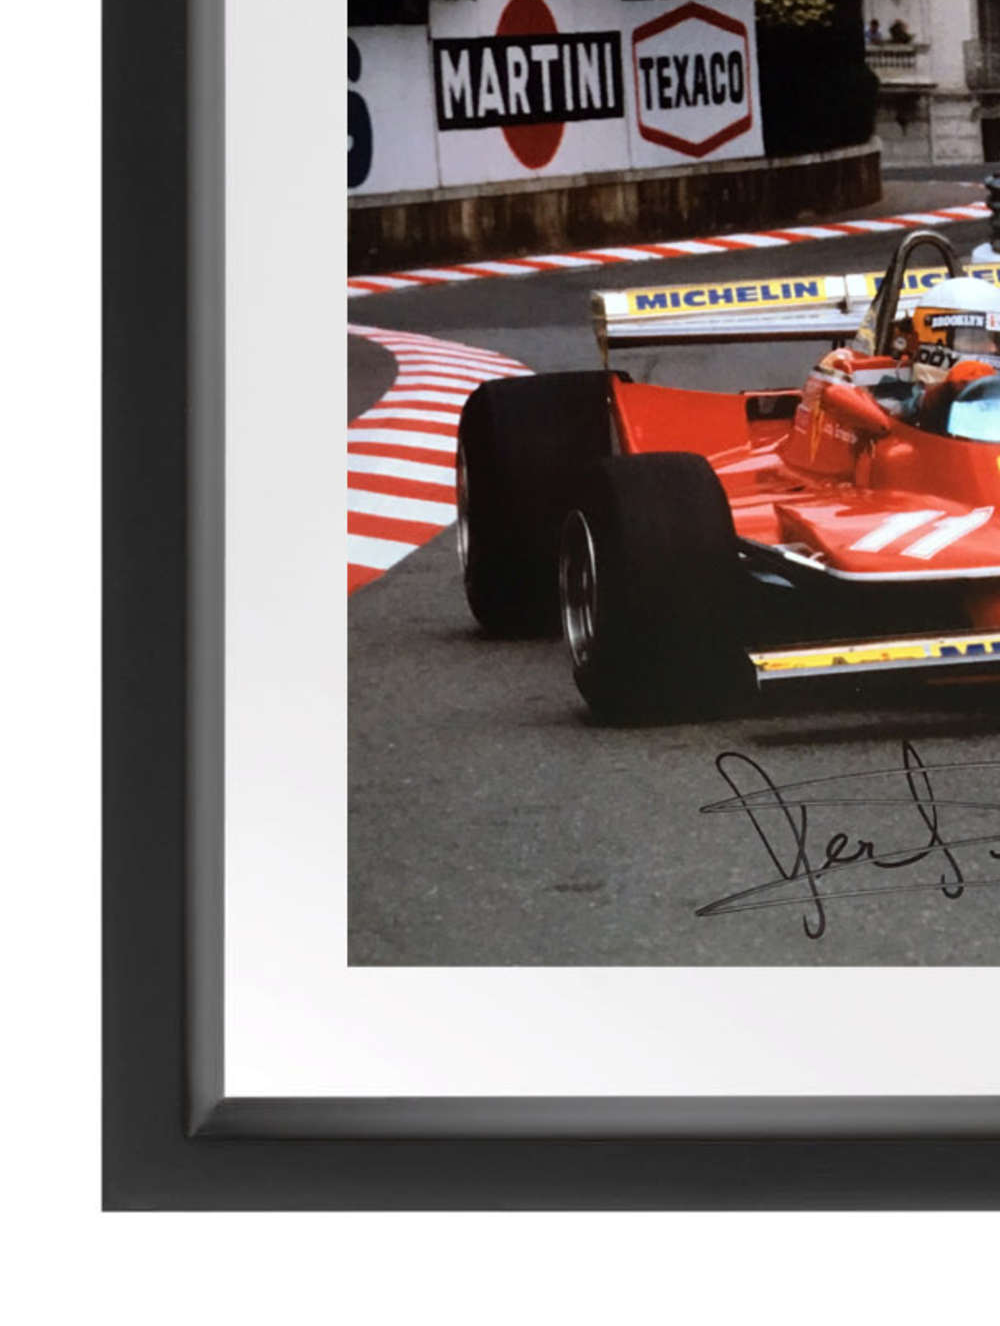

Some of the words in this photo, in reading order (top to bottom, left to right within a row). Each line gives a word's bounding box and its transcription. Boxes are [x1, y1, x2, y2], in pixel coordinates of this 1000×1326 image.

[439, 41, 617, 120] MARTINI
[639, 50, 745, 111] TEXACO
[635, 280, 819, 311] MICHELIN
[848, 505, 995, 560] 11
